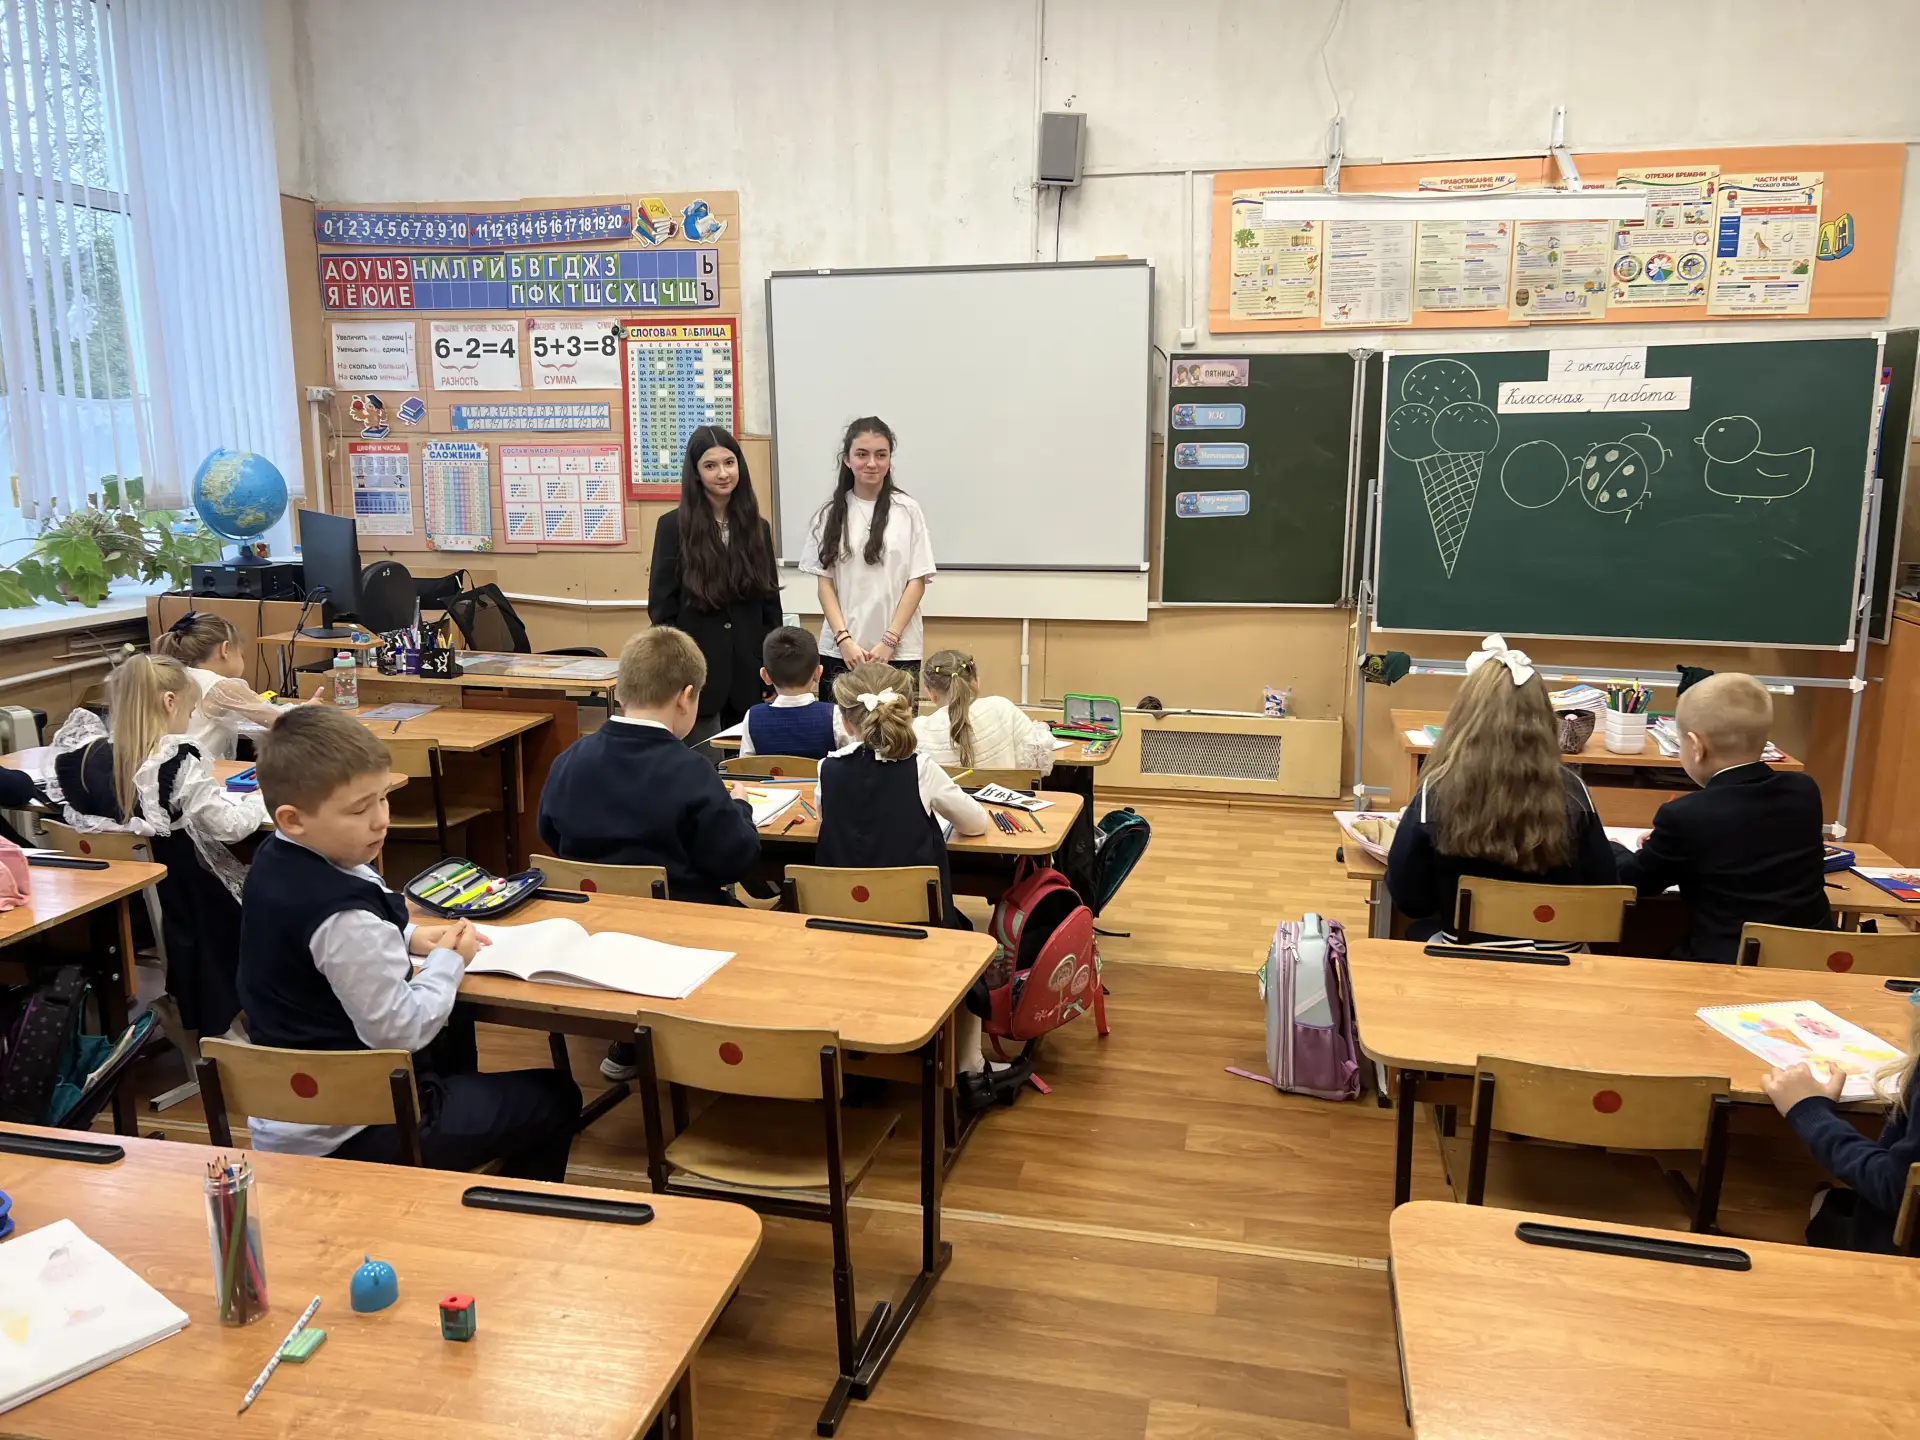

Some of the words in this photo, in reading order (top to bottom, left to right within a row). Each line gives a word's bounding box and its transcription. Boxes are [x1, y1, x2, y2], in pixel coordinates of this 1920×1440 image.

[324, 220, 333, 235] 0
[337, 220, 343, 234] 1
[348, 221, 357, 235] 2
[362, 221, 370, 235] 3
[375, 222, 383, 236] 4
[388, 222, 396, 236] 5
[401, 222, 409, 237] 6
[413, 222, 421, 237] 7
[426, 223, 434, 238] 8
[438, 223, 447, 238] 9
[451, 223, 466, 238] 10
[476, 224, 488, 238] 11
[490, 223, 503, 238] 12
[505, 222, 518, 236] 13
[520, 221, 533, 236] 14
[535, 220, 547, 235] 15
[549, 219, 562, 233] 16
[564, 218, 577, 232] 17
[579, 217, 591, 232] 18
[593, 216, 605, 230] 19
[608, 214, 622, 229] 20
[631, 328, 677, 338] СЛОГОВАЯ
[683, 327, 726, 338] ТАБЛИЦА
[435, 337, 516, 359] 6-2=4
[534, 335, 616, 357] 5+3=8
[1564, 360, 1572, 372] 2
[1578, 354, 1641, 376] октября
[1205, 369, 1235, 378] ПЯТНИЦА
[441, 376, 479, 386] РАЗНОСТЬ
[544, 376, 577, 385] СУММА
[1504, 388, 1585, 405] Классная
[1603, 384, 1677, 410] работа
[1208, 411, 1225, 420] ИЗО
[433, 443, 476, 451] ТАБЛИЦА
[430, 451, 481, 459] СЛОЖЕНИЯ
